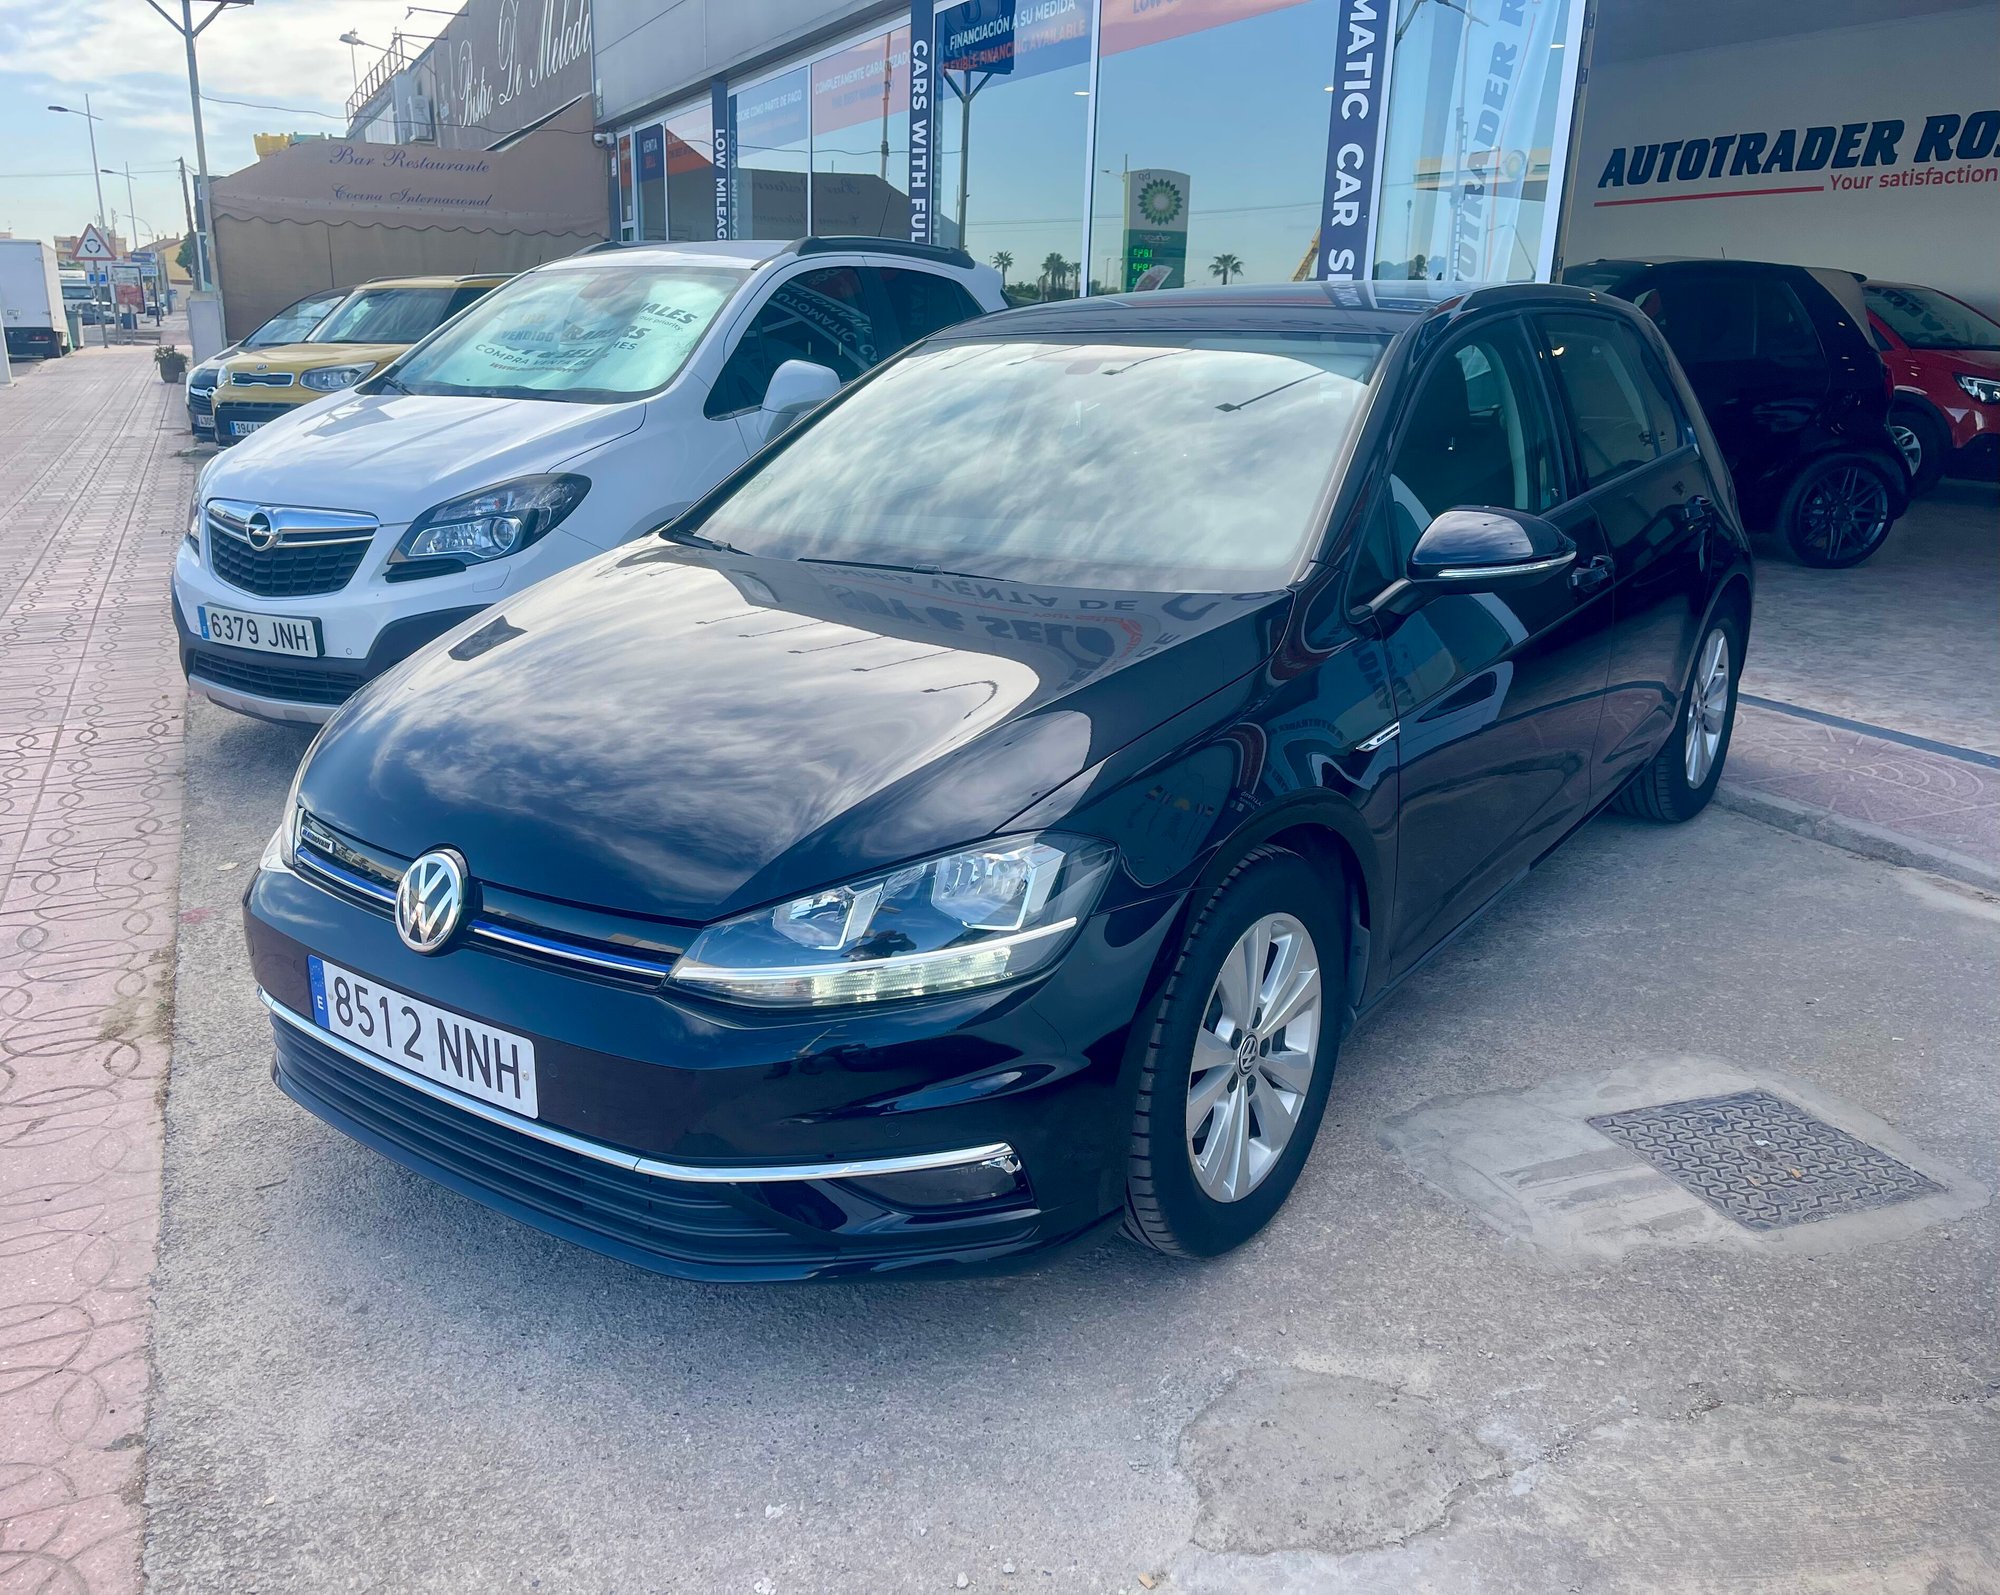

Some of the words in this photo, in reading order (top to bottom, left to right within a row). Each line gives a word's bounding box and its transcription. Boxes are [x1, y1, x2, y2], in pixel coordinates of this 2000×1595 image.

[949, 16, 1010, 51] FINANCIACIÓN
[1011, 17, 1019, 30] A
[1020, 8, 1033, 27] SU
[1035, 0, 1076, 22] MEDIDA
[978, 36, 1030, 65] FINANCING
[1030, 19, 1086, 49] AVAILABLE
[459, 40, 493, 128] Bistro
[912, 40, 928, 110] CARS
[1341, 0, 1378, 120] MATIC
[329, 144, 375, 166] Bar
[383, 149, 489, 173] Restaurante
[715, 129, 726, 169] LOW
[911, 119, 927, 189] WITH
[1458, 40, 1518, 281] OTRADER
[1597, 119, 1905, 188] AUTOTRADER
[1914, 110, 2000, 164] RO
[331, 183, 383, 201] Cocina
[390, 188, 493, 207] Internacional
[1331, 143, 1364, 227] CAR
[1830, 172, 1874, 191] Your
[1879, 164, 1998, 188] satisfaction
[716, 178, 727, 240] MILEAG
[911, 198, 927, 243] FUL
[475, 343, 530, 365] COMPRA
[501, 329, 555, 342] VENDIDO
[211, 612, 259, 645] 6379
[267, 621, 308, 652] JNH
[316, 995, 324, 1010] E
[334, 975, 424, 1063] 8512
[436, 1016, 522, 1100] NNH
